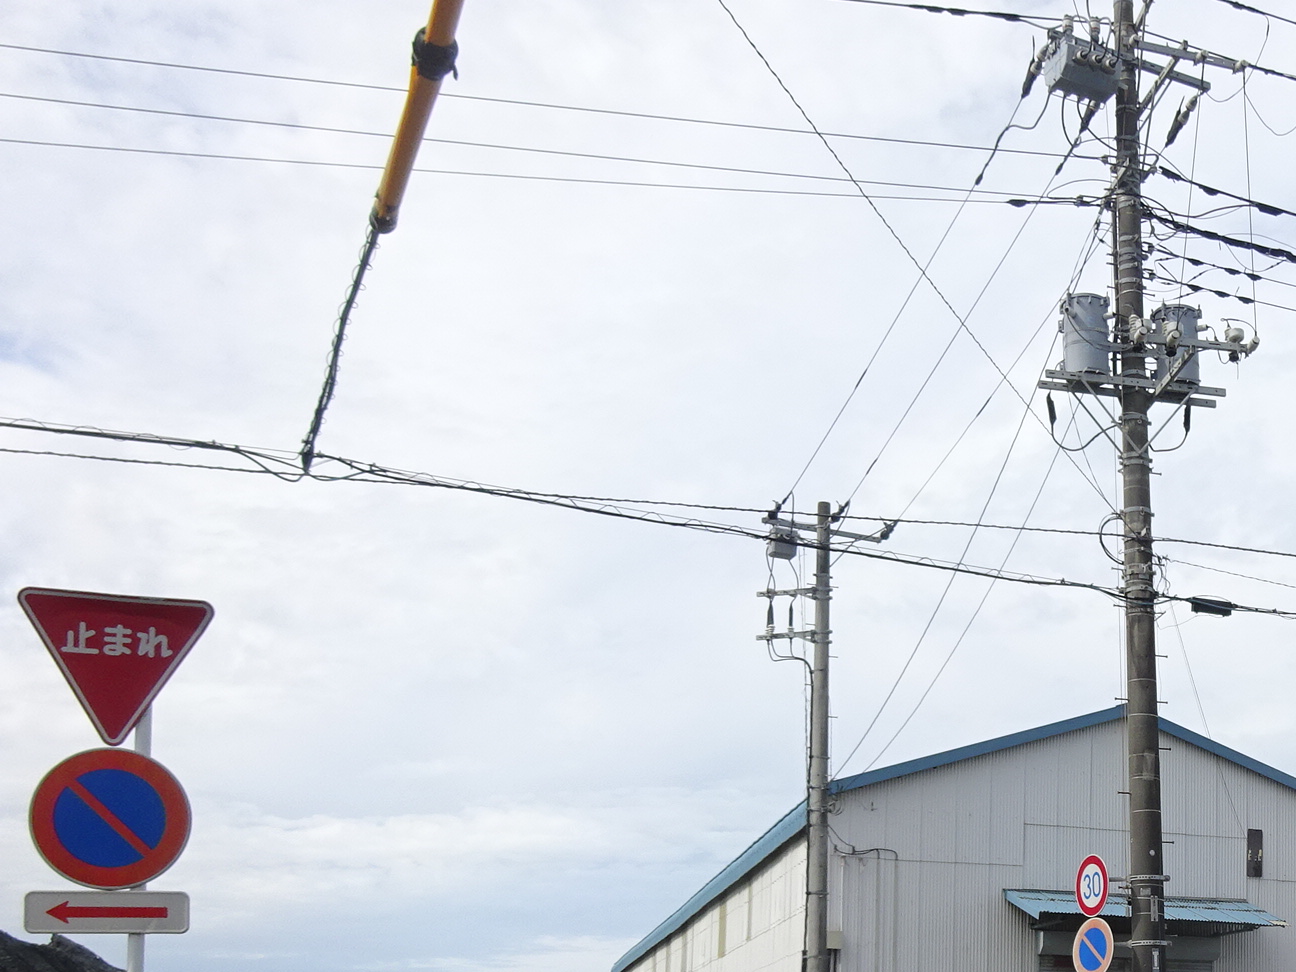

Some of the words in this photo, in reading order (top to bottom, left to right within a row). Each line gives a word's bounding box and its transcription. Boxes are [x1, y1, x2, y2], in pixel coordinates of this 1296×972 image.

[60, 621, 173, 658] 止まれ
[1083, 871, 1101, 900] 30
